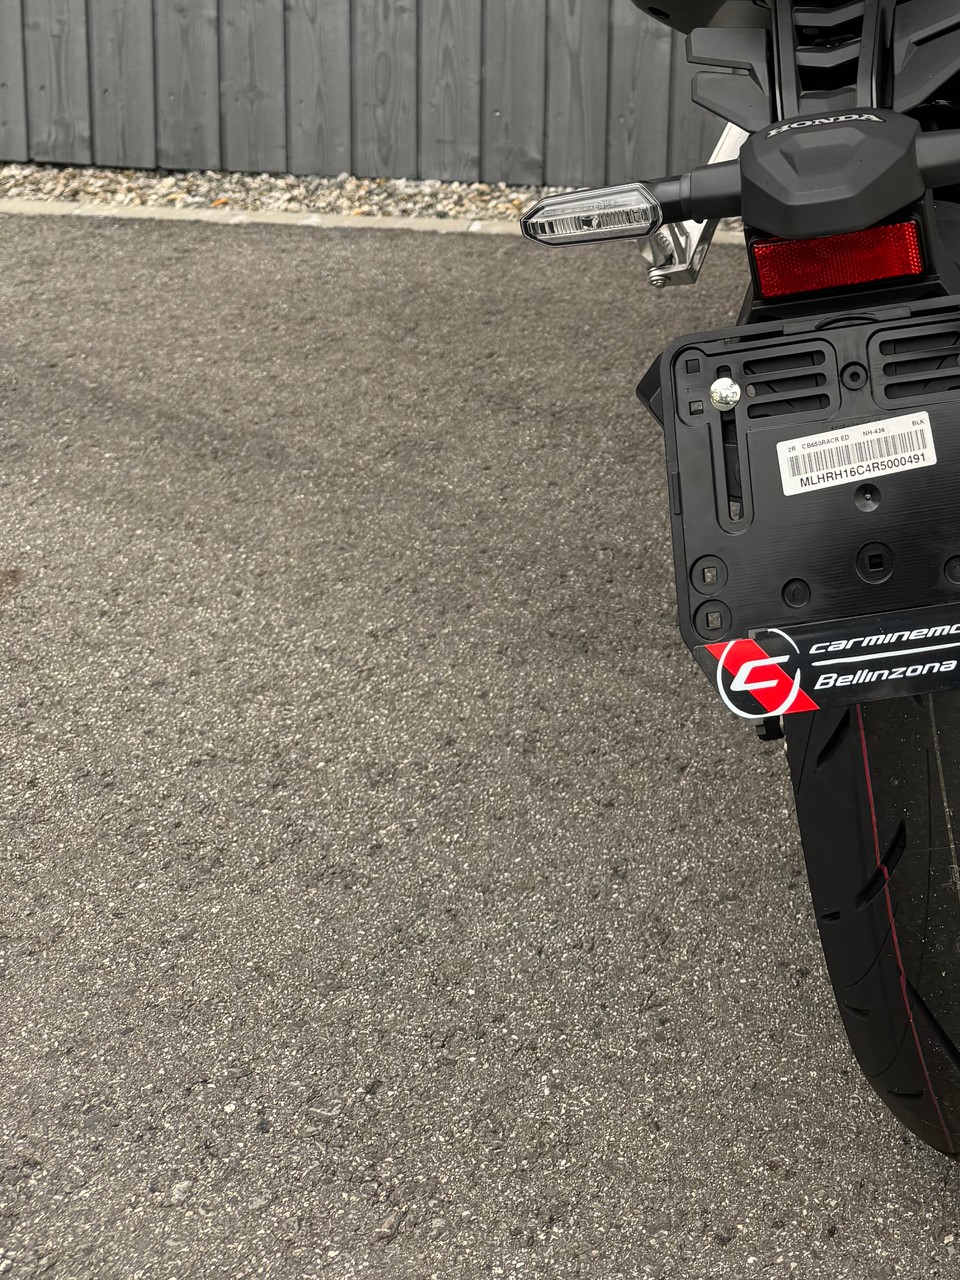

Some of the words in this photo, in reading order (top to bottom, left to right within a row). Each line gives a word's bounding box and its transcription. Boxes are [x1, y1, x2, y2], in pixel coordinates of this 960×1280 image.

[767, 113, 883, 138] HONDA
[840, 434, 850, 442] ED
[911, 418, 925, 427] BLK
[799, 452, 927, 488] MLHRH16C4R5000491
[814, 659, 958, 691] Bellinzona
